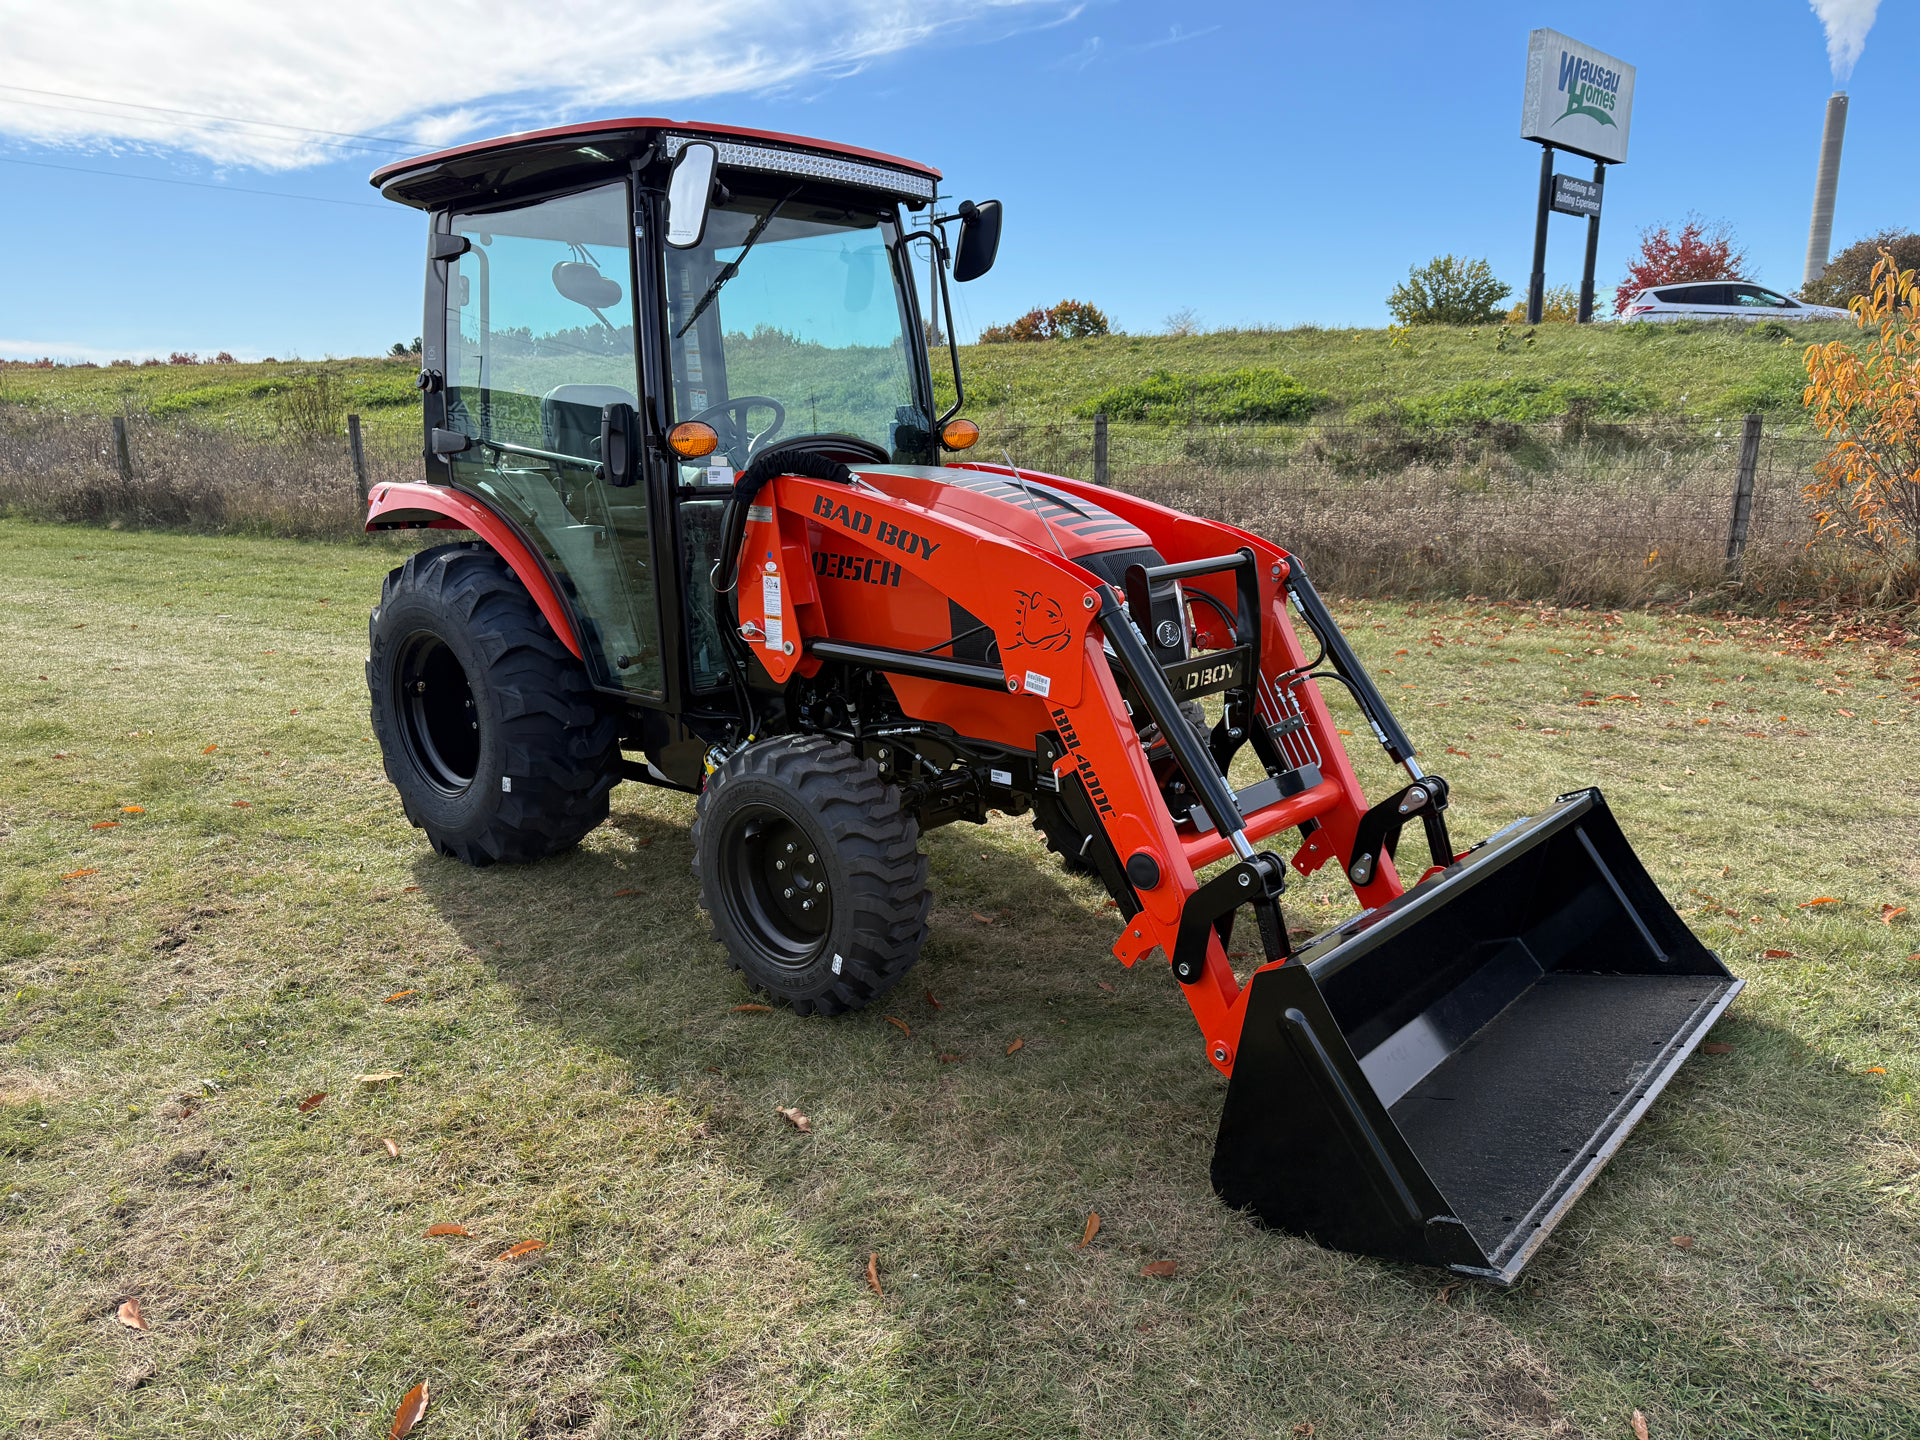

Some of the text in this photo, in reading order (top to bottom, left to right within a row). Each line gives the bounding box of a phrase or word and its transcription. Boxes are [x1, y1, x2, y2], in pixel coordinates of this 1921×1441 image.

[1558, 50, 1621, 94] Wausau
[1567, 80, 1616, 112] Homes
[1556, 191, 1600, 211] Building Experience
[1562, 178, 1596, 196] Redefining the
[813, 494, 941, 561] BAD BOY
[1200, 661, 1239, 686] BOY
